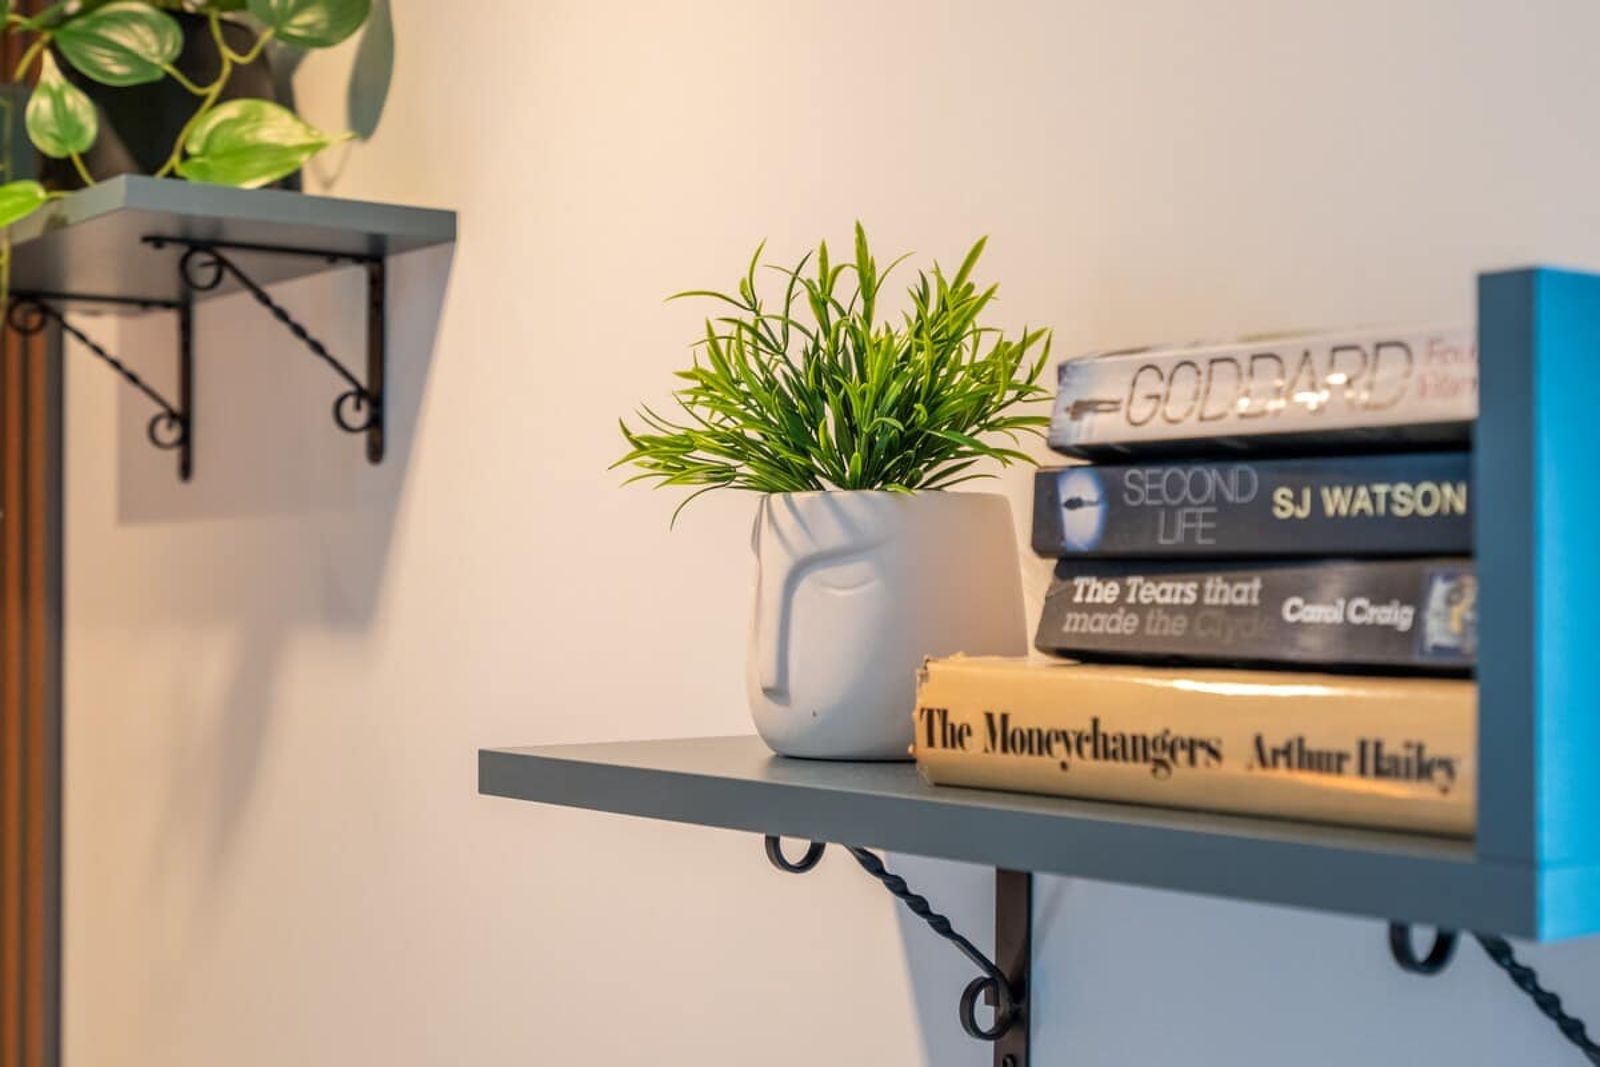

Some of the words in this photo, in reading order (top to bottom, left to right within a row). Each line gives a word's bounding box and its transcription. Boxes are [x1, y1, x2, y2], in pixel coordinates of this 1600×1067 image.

[1124, 342, 1412, 426] GODDARD
[1123, 465, 1259, 506] SECOND
[1272, 485, 1311, 519] SJ
[1321, 482, 1467, 517] WATSON
[1157, 507, 1217, 546] LIFE
[1073, 576, 1120, 604] The
[1126, 576, 1198, 604] Tears
[1203, 576, 1262, 606] that
[1062, 608, 1140, 635] made
[1145, 610, 1188, 636] the
[1281, 596, 1346, 624] Carol
[1347, 597, 1415, 632] Craig
[919, 707, 972, 752] The
[983, 711, 1221, 781] Moneychangers
[1248, 733, 1348, 775] Arthur
[1358, 739, 1459, 795] Hailey
